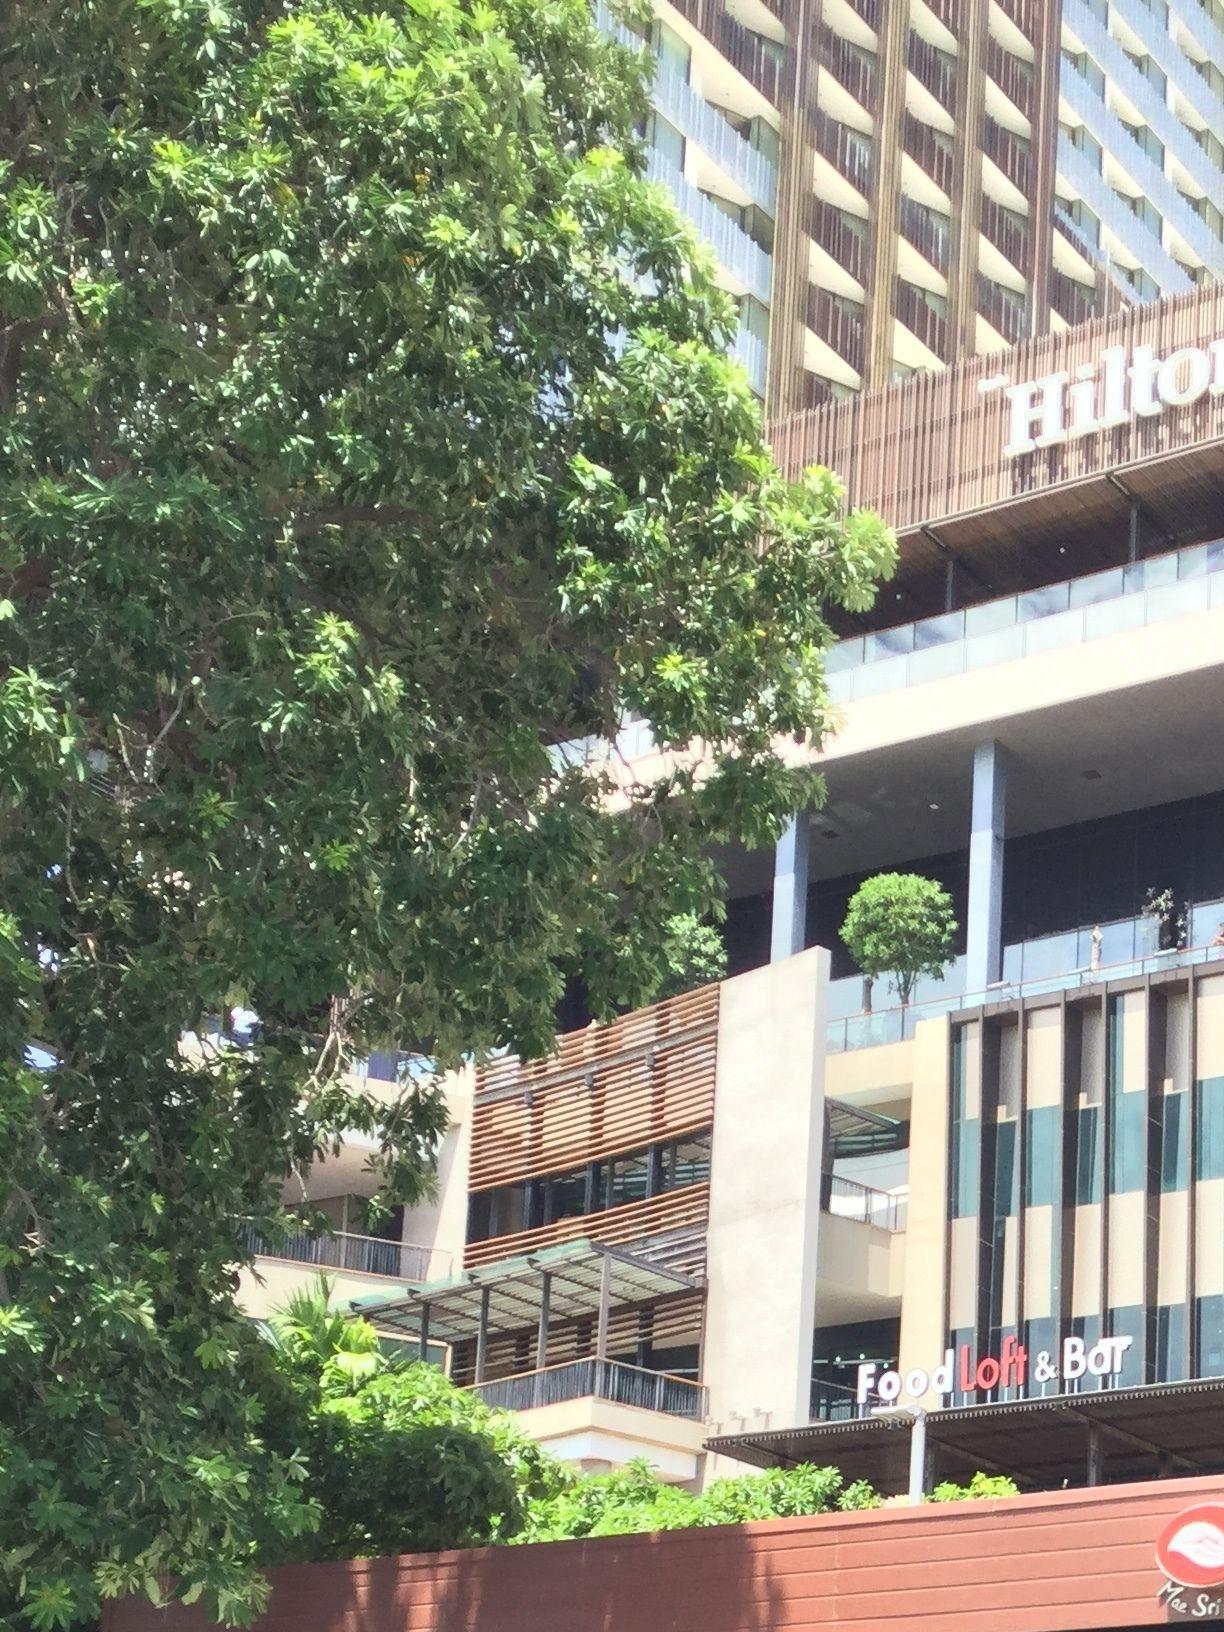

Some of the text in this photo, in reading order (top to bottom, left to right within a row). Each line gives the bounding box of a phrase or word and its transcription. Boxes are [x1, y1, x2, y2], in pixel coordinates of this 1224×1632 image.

[857, 1335, 1133, 1404] Food Loft & Bar
[1156, 1580, 1188, 1614] Mae
[1191, 1593, 1222, 1617] Sri
